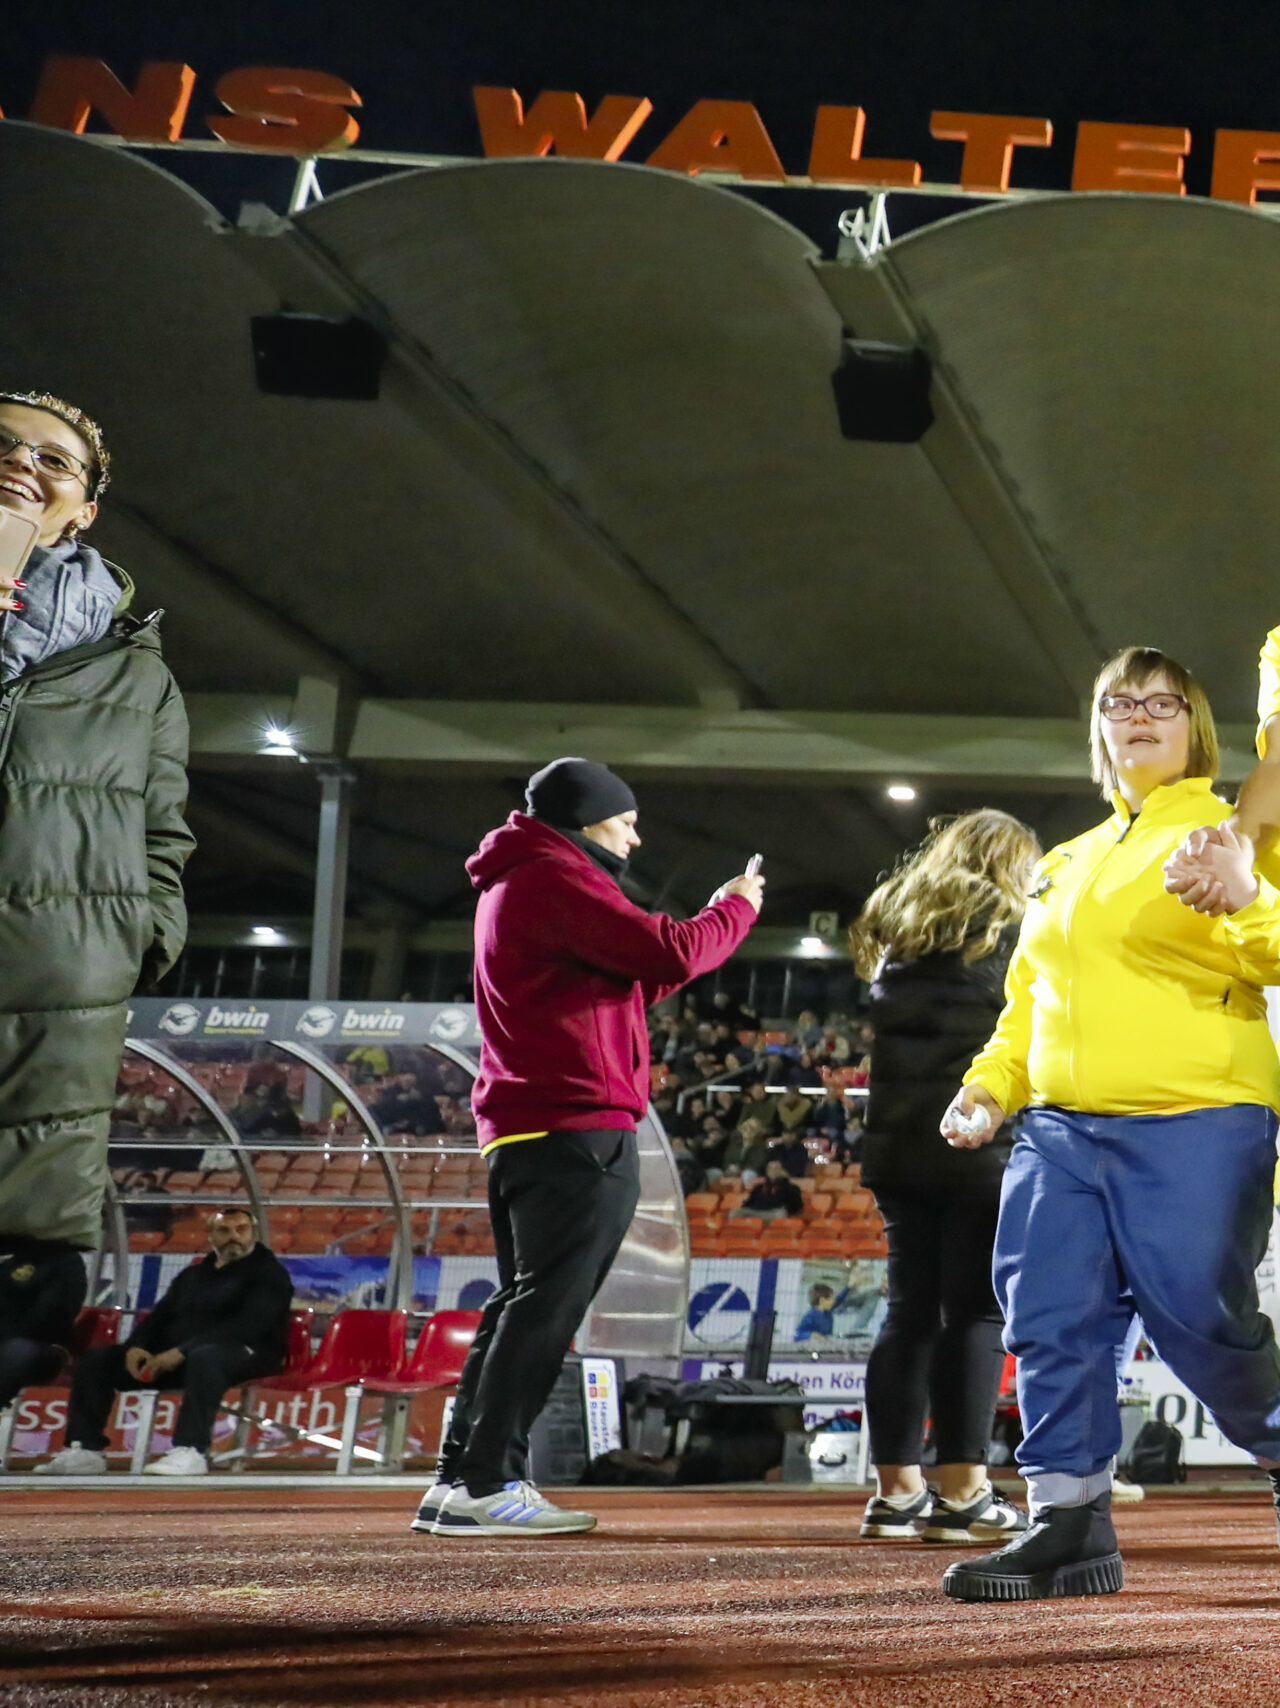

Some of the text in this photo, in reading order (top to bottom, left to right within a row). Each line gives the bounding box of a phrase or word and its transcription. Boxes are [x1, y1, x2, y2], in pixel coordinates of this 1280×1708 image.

[0, 56, 363, 155] NS
[204, 1005, 270, 1028] bwin
[341, 1007, 405, 1030] bwin
[830, 1370, 867, 1389] Kön
[115, 1389, 336, 1431] Bauth
